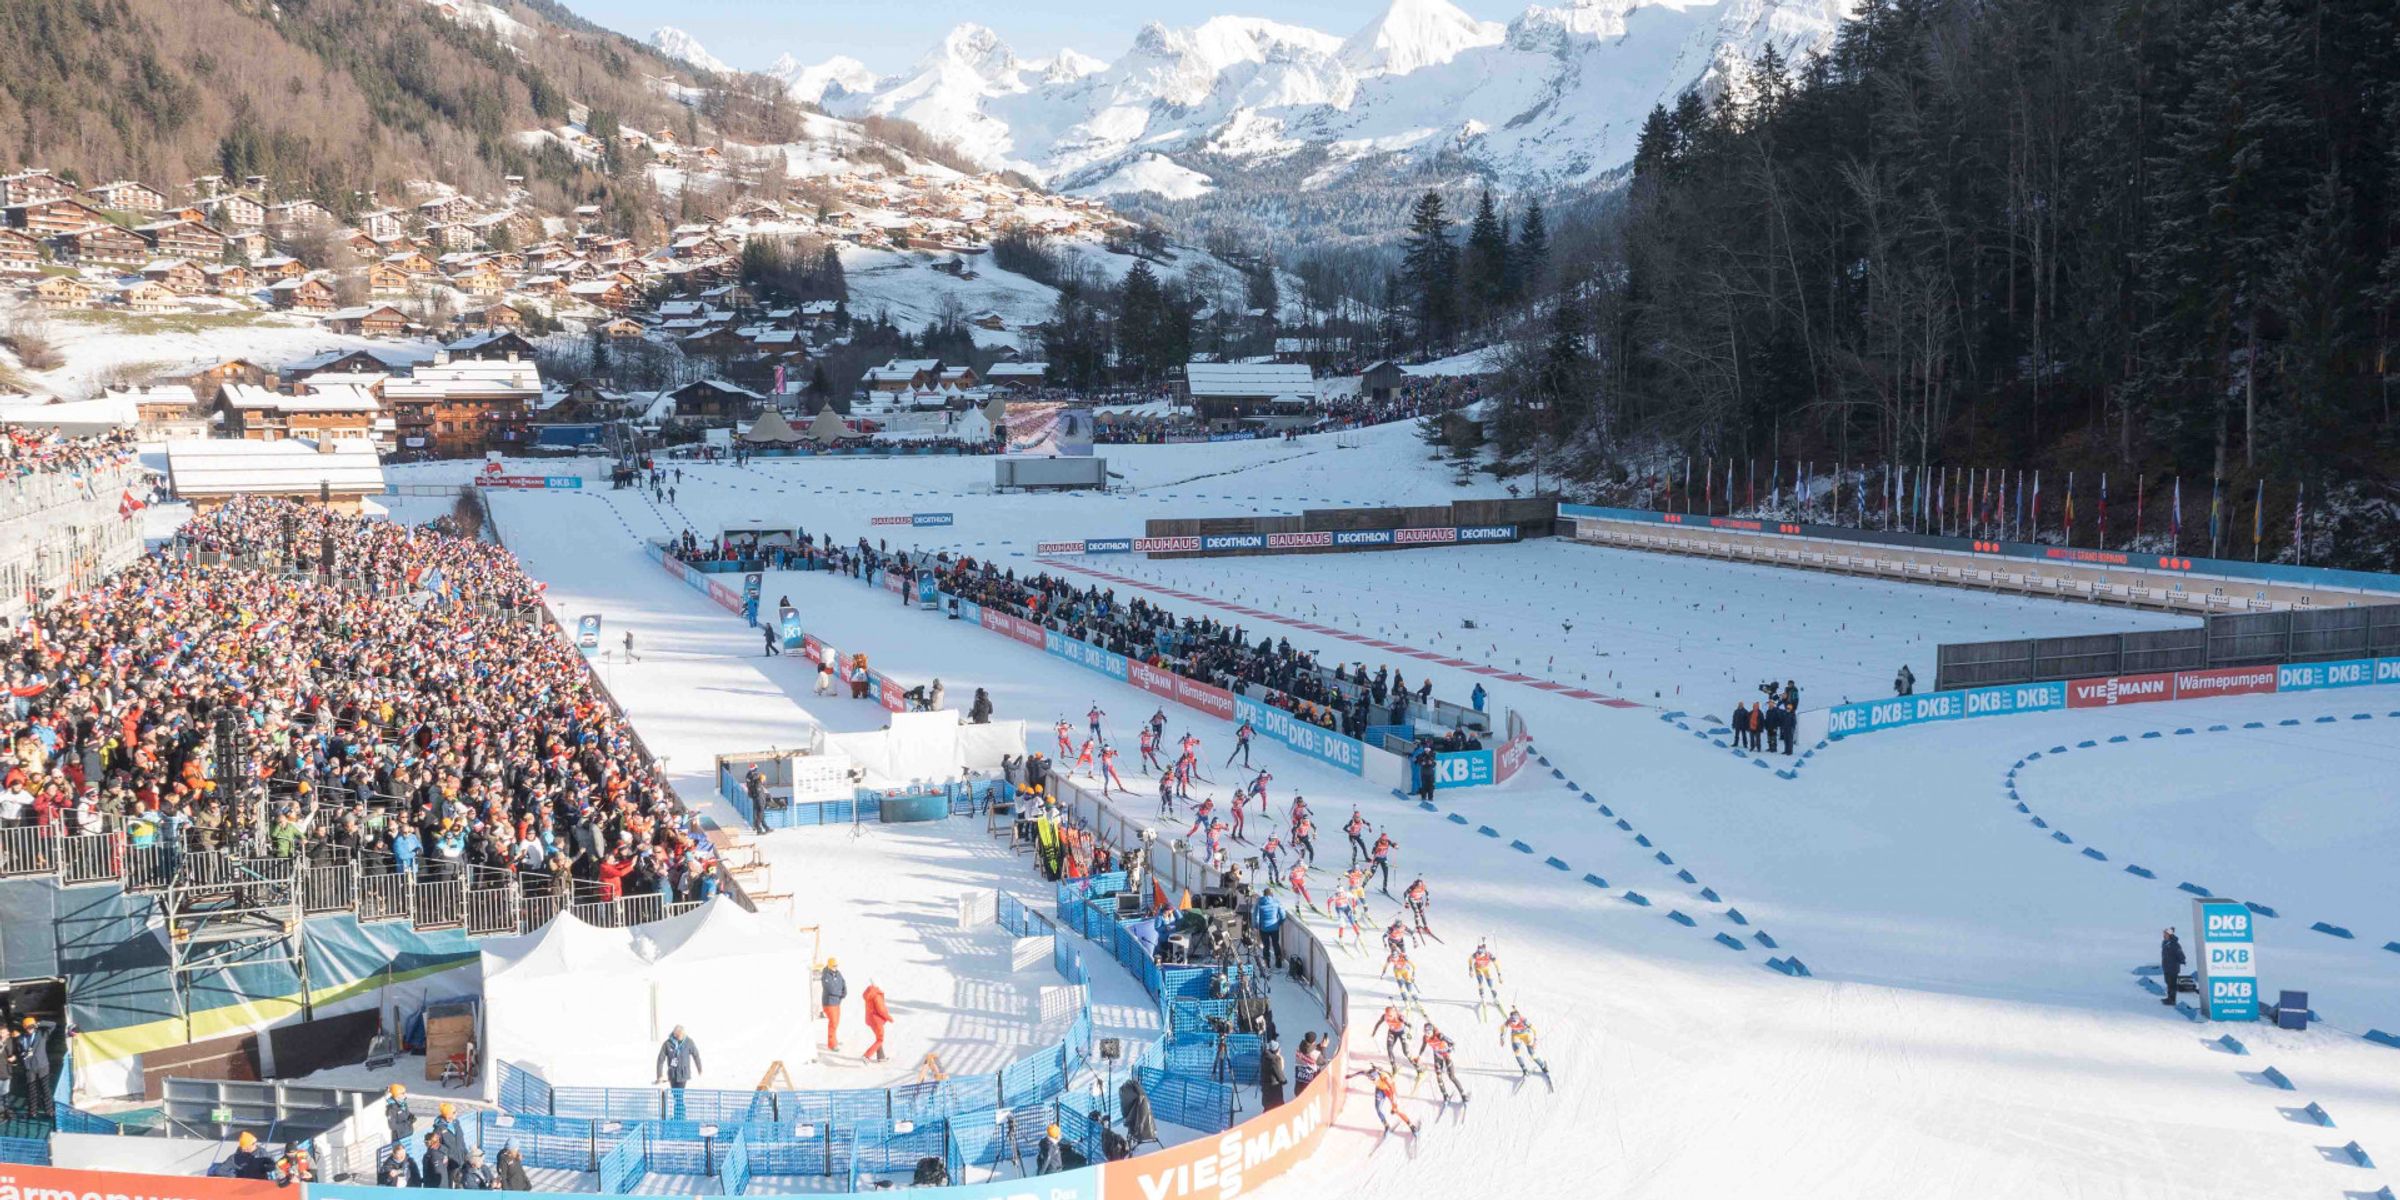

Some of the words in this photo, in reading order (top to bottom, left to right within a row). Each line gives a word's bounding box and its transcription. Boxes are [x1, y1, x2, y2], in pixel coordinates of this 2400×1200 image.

[1207, 536, 1261, 547] DECATHLON
[1269, 534, 1331, 546] BAUHAUS
[1338, 532, 1389, 543] DECATHLON
[1396, 529, 1455, 542] BAUHAUS
[1462, 528, 1511, 539] DECATHLON
[1088, 541, 1129, 550] DECATHLON
[1134, 537, 1199, 550] BAUHAUS
[1063, 641, 1077, 659] DKB
[1085, 650, 1099, 667] DKB
[1106, 656, 1121, 674] DKB
[2328, 665, 2360, 682] DKB
[2378, 662, 2400, 678] DK
[1132, 665, 1171, 689] VIESSMANN
[2179, 672, 2273, 691] Wärmepumpen
[2280, 667, 2313, 687] DKB
[1178, 682, 1232, 711] Wärmepumpen
[1968, 690, 2001, 712] DKB
[2016, 687, 2049, 708] DKB
[2077, 678, 2164, 705] VIESSMANN
[1236, 700, 1256, 724] DKB
[1871, 703, 1902, 725] DKB
[1917, 697, 1950, 717] DKB
[1266, 710, 1288, 736] DKB
[1829, 710, 1857, 732] DKB
[1289, 725, 1314, 750] DKB
[1324, 736, 1350, 764] DKB
[1435, 758, 1469, 783] KB
[2208, 915, 2248, 930] DKB
[2212, 949, 2249, 963] DKB
[2213, 982, 2252, 997] DKB
[1138, 1095, 1323, 1200] VIESSMANN
